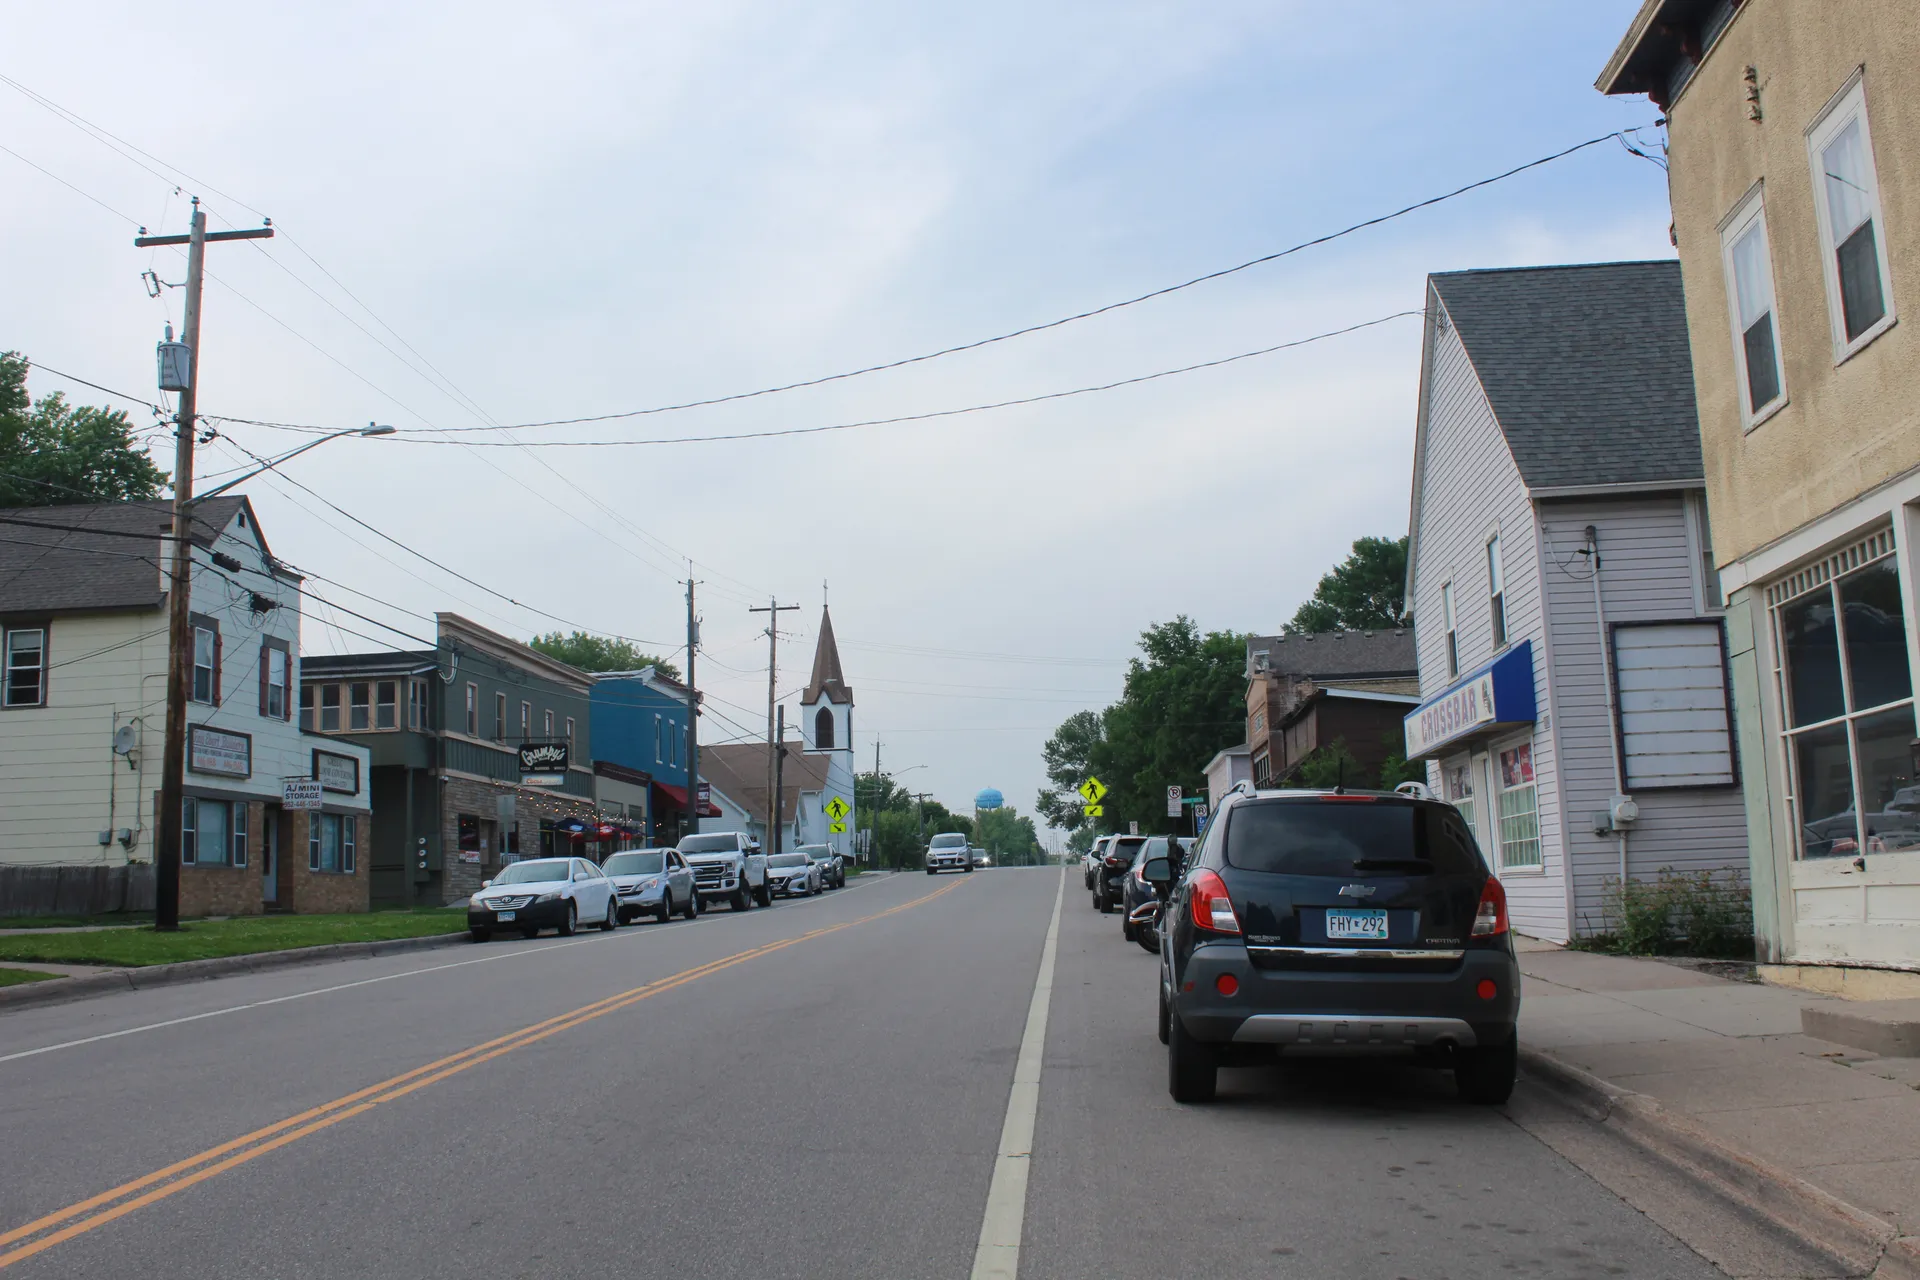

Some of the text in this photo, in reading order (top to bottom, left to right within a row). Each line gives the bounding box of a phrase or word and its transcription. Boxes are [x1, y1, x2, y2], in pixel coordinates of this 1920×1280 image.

[1421, 686, 1477, 743] CROSSBAR
[521, 745, 566, 766] Grumpy's
[285, 792, 320, 800] STORAGE
[1330, 916, 1385, 932] FHY 292
